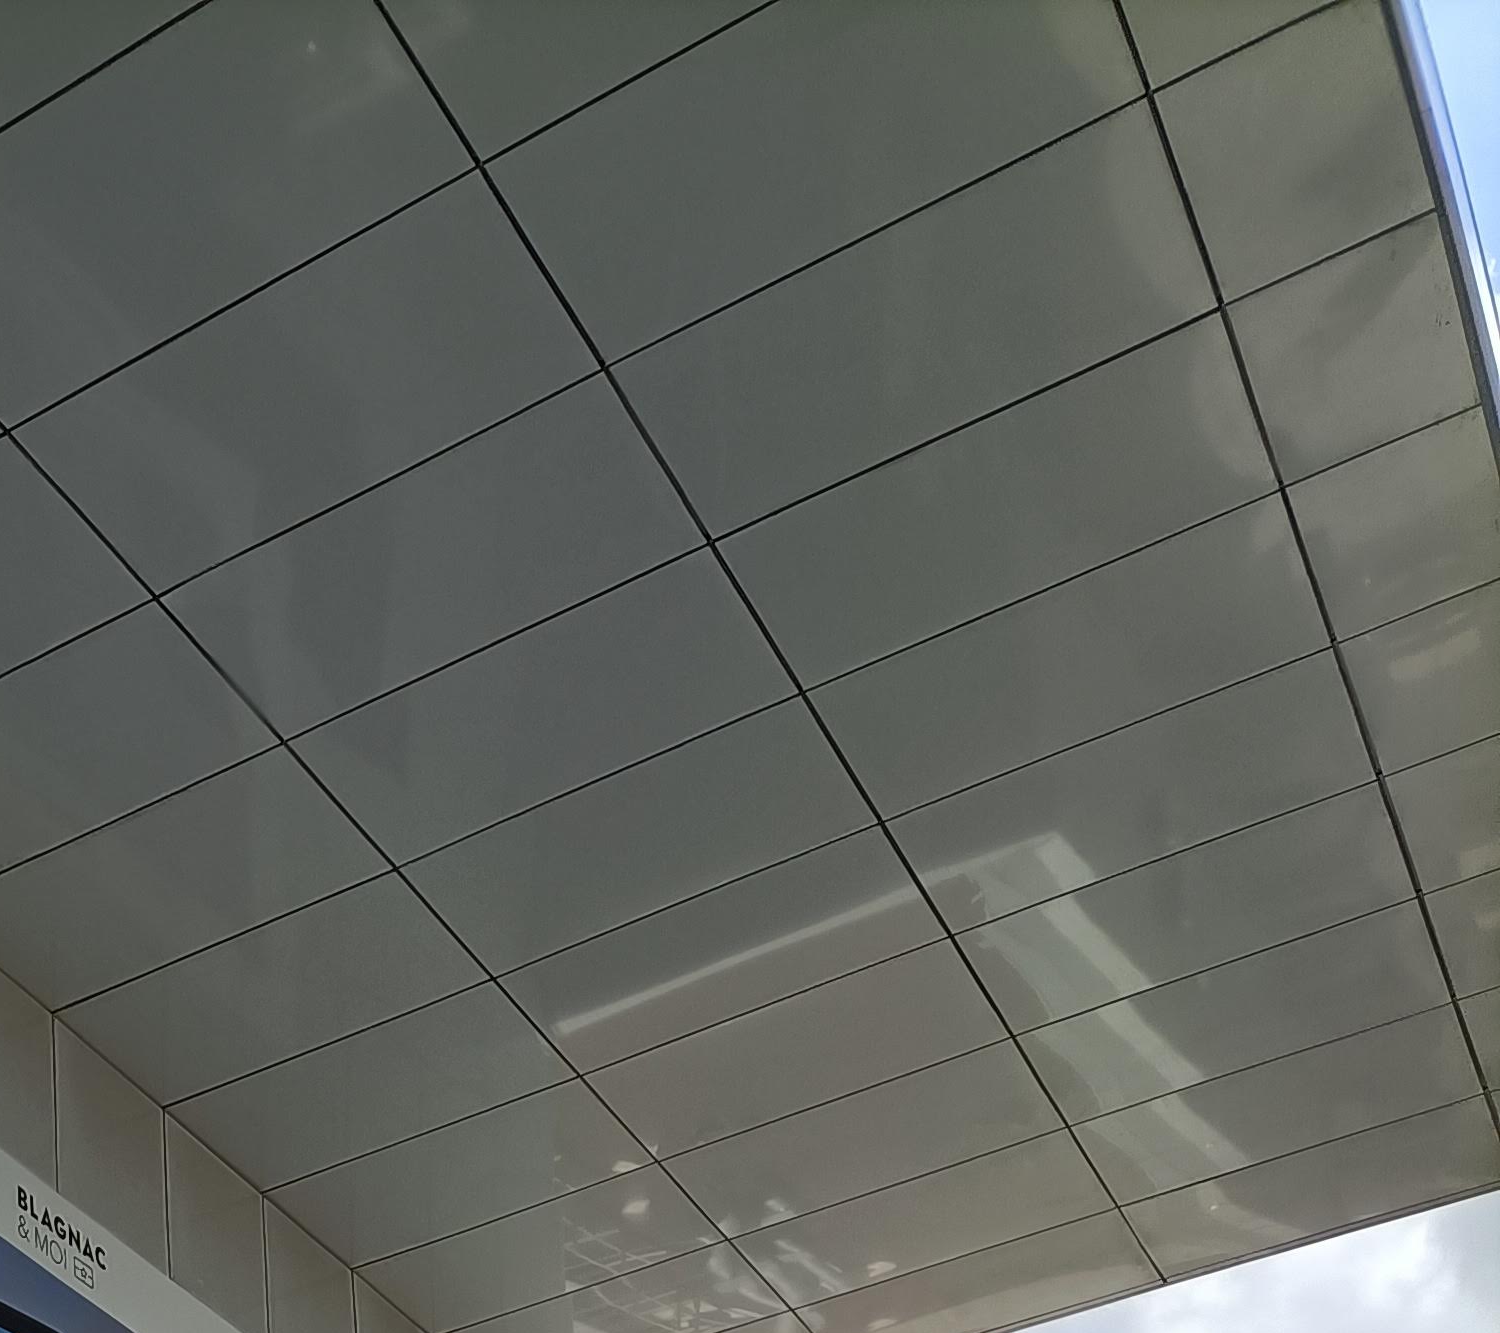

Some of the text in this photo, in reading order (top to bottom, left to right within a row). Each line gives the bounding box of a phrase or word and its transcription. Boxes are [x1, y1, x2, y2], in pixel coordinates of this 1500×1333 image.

[18, 1185, 107, 1271] BLAGNAC
[18, 1215, 67, 1270] & MOI
